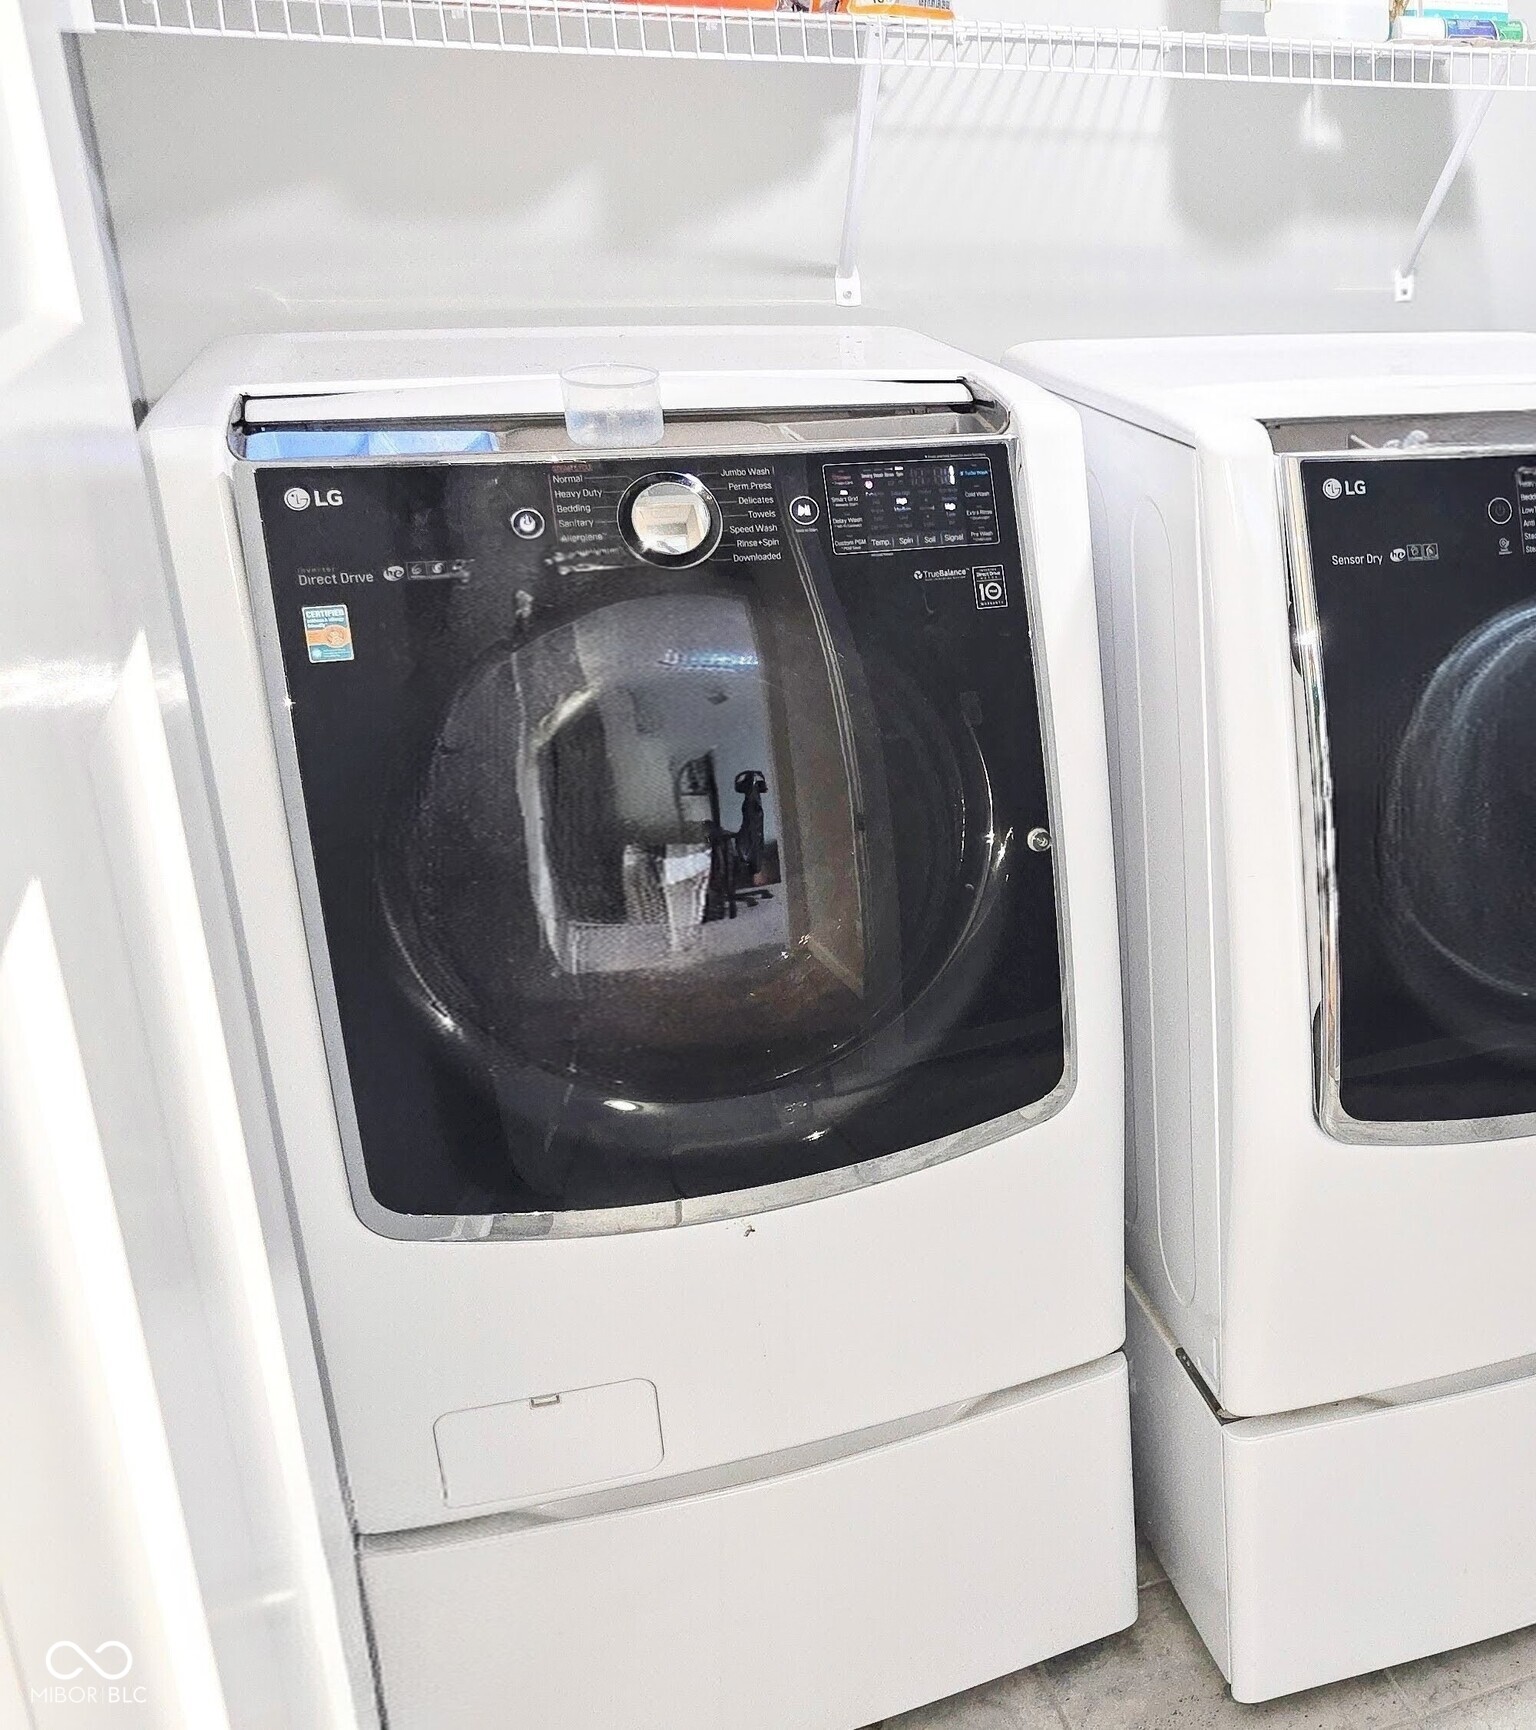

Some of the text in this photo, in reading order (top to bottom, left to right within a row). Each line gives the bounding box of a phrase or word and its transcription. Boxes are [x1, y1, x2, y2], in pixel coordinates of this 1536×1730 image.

[721, 467, 770, 477] Jumbo Wash
[552, 474, 583, 483] Normal
[1345, 480, 1366, 495] LG
[314, 489, 343, 507] LG
[554, 488, 602, 499] Heavy Duty
[738, 496, 774, 505] Delicates
[556, 504, 591, 513] Bedding
[748, 510, 776, 518] Towels
[559, 519, 594, 528] Sanitary
[729, 524, 778, 534] Speed Wash
[899, 537, 914, 545] Spin
[944, 533, 964, 542] Signal
[733, 552, 782, 562] Downloaded
[1331, 553, 1383, 566] Sensor Dry
[298, 571, 374, 586] Direct Drive
[978, 582, 1002, 601] 10
